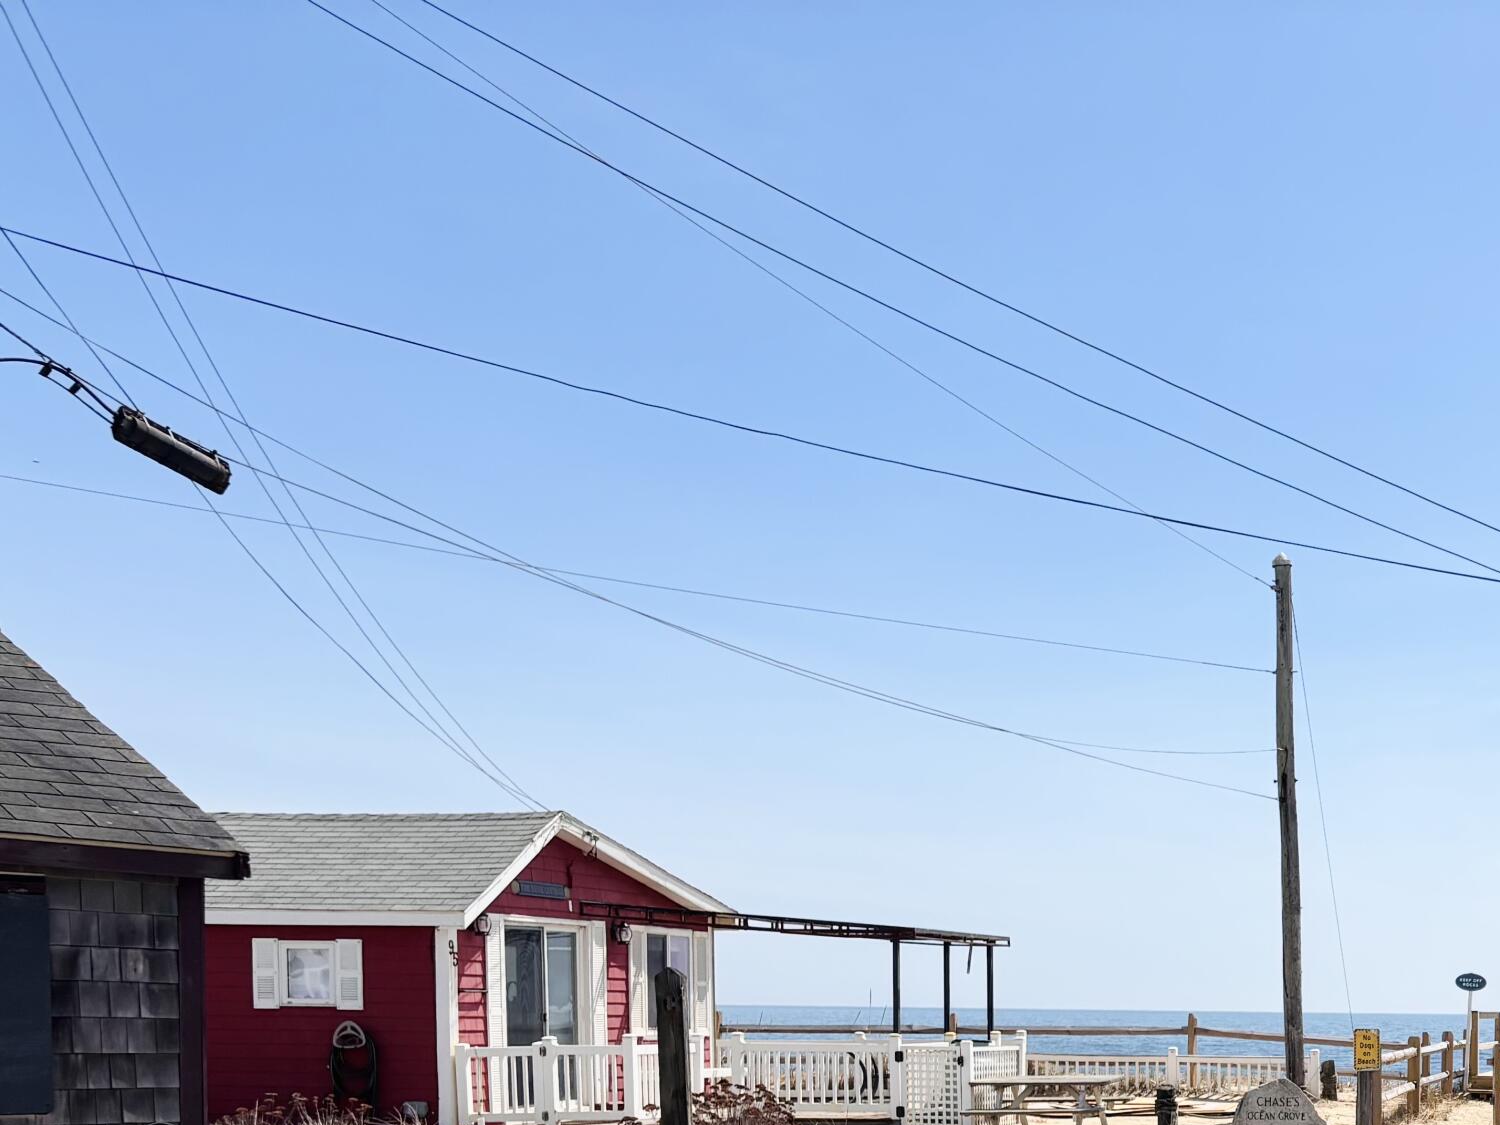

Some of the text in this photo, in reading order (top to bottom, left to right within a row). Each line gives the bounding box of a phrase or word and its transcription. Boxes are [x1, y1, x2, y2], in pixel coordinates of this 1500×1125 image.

[1359, 1042, 1375, 1050] Dogs
[1256, 1095, 1300, 1107] CHASE'S
[1247, 1110, 1306, 1121] OCEAN GROVE
